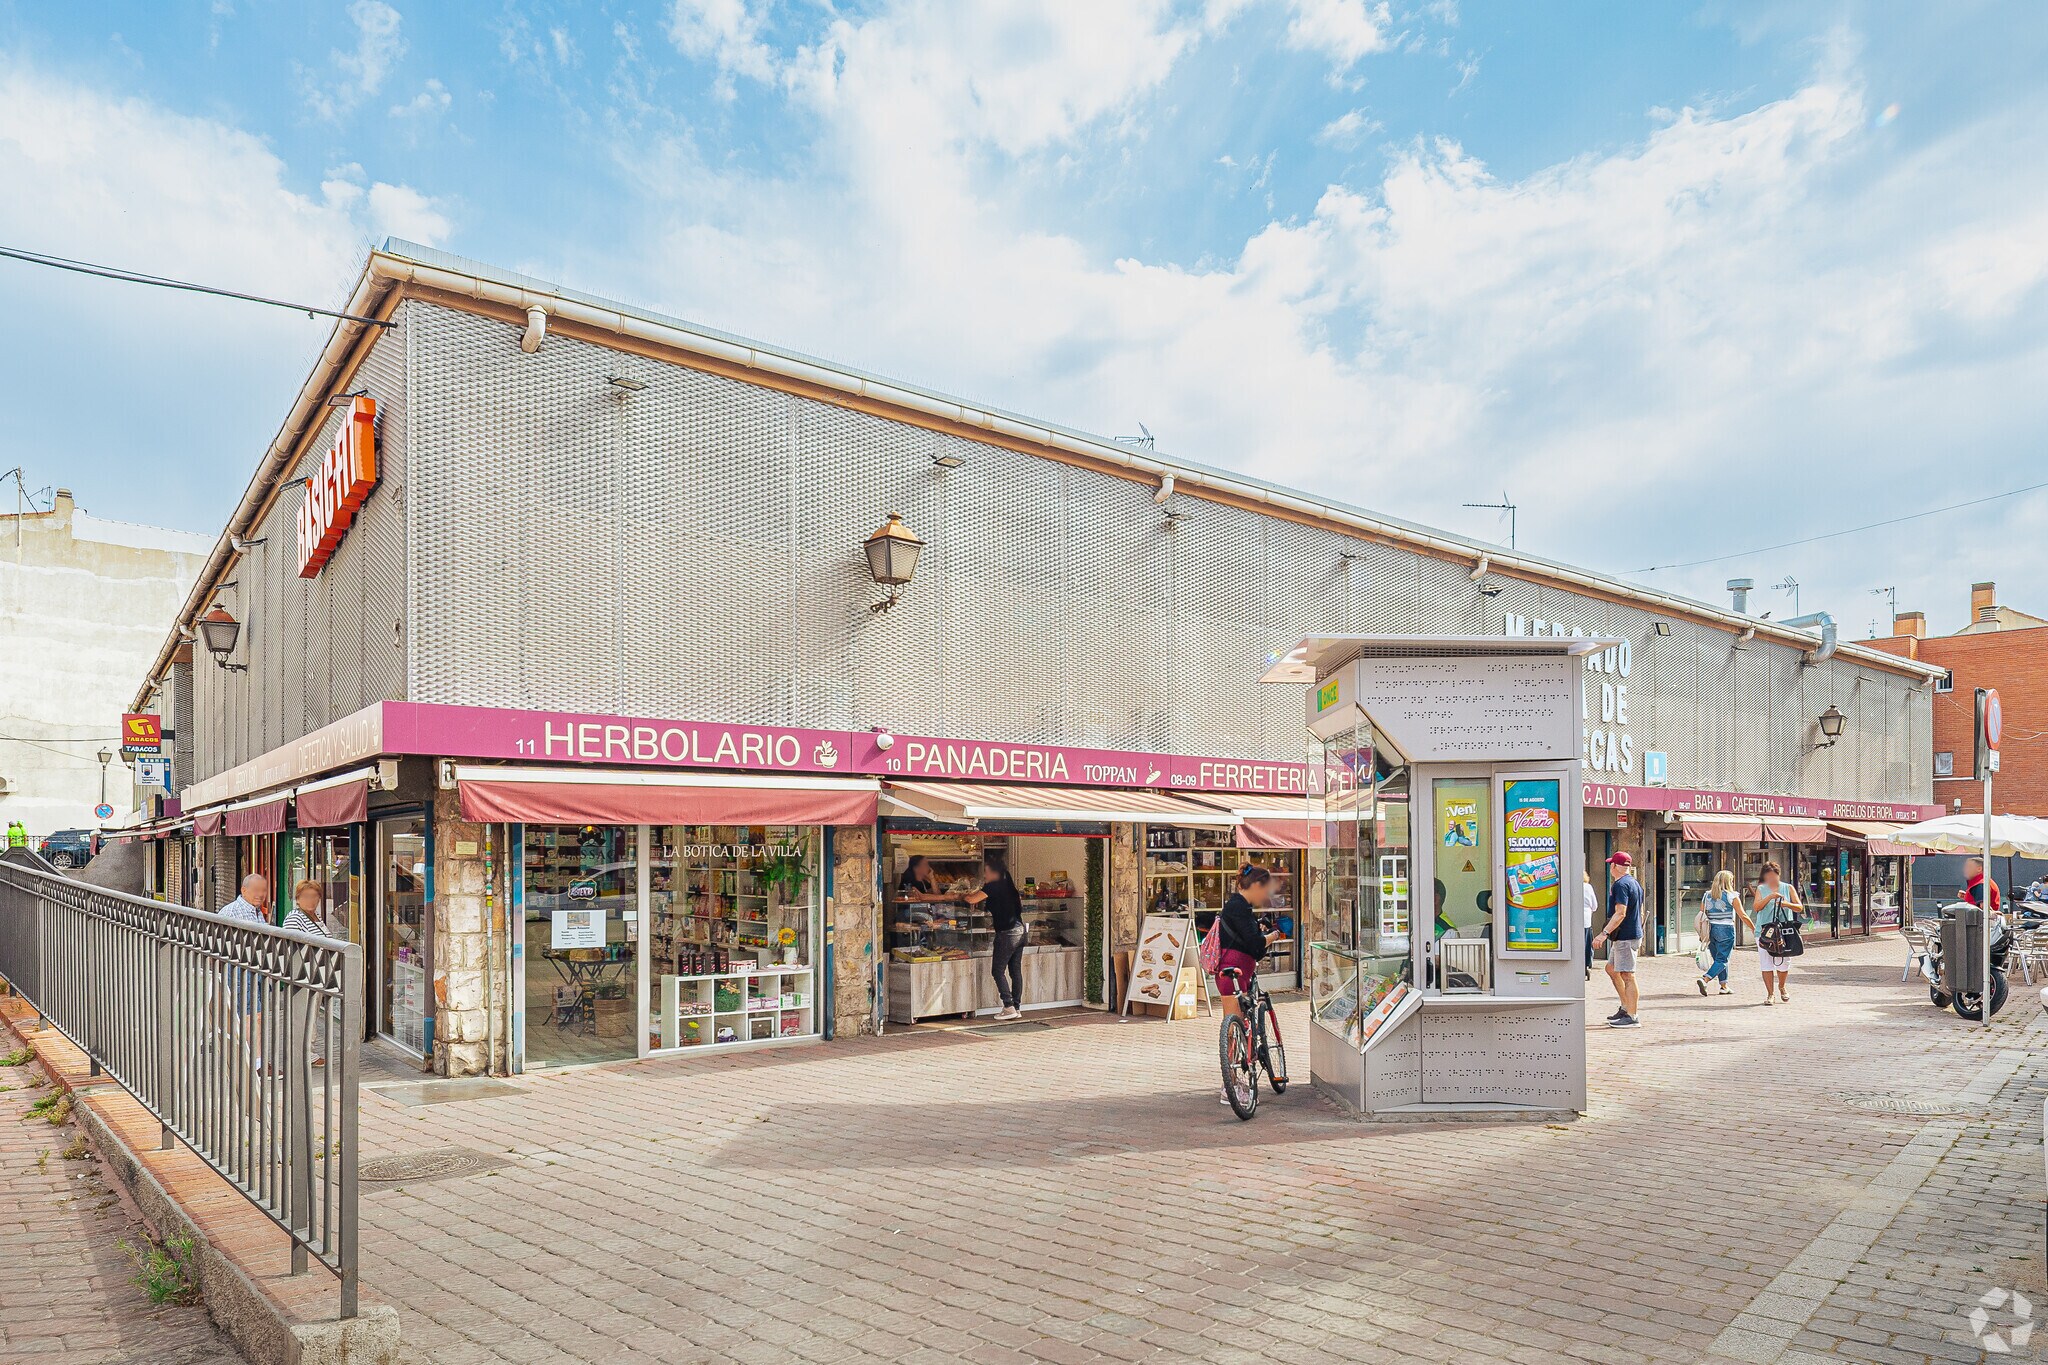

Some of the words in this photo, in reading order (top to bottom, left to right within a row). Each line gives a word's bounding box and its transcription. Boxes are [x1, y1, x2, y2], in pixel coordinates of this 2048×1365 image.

[1602, 683, 1628, 725] DE
[125, 745, 158, 753] TABACOS
[340, 719, 369, 760] SALUD
[515, 738, 535, 755] 11
[544, 720, 801, 767] HERBOLARIO
[886, 758, 901, 772] 10
[906, 742, 1070, 780] PANADERIA
[1083, 764, 1137, 784] TOPPAN
[1170, 774, 1197, 786] 08-09
[1200, 762, 1320, 792] FERRETERIA
[1582, 785, 1629, 807] CADO
[1694, 794, 1714, 810] BAR
[1731, 796, 1776, 814] CAFETERIA
[1445, 803, 1477, 818] ¡Ven!
[1509, 808, 1555, 833] Verano
[1832, 803, 1867, 818] ARREGLOS
[1867, 806, 1877, 819] DE
[1877, 806, 1893, 819] ROPA
[663, 845, 680, 858] LA
[683, 845, 729, 858] BOTICA
[732, 845, 749, 857] DE
[751, 845, 769, 857] LA
[769, 845, 802, 858] VILLA
